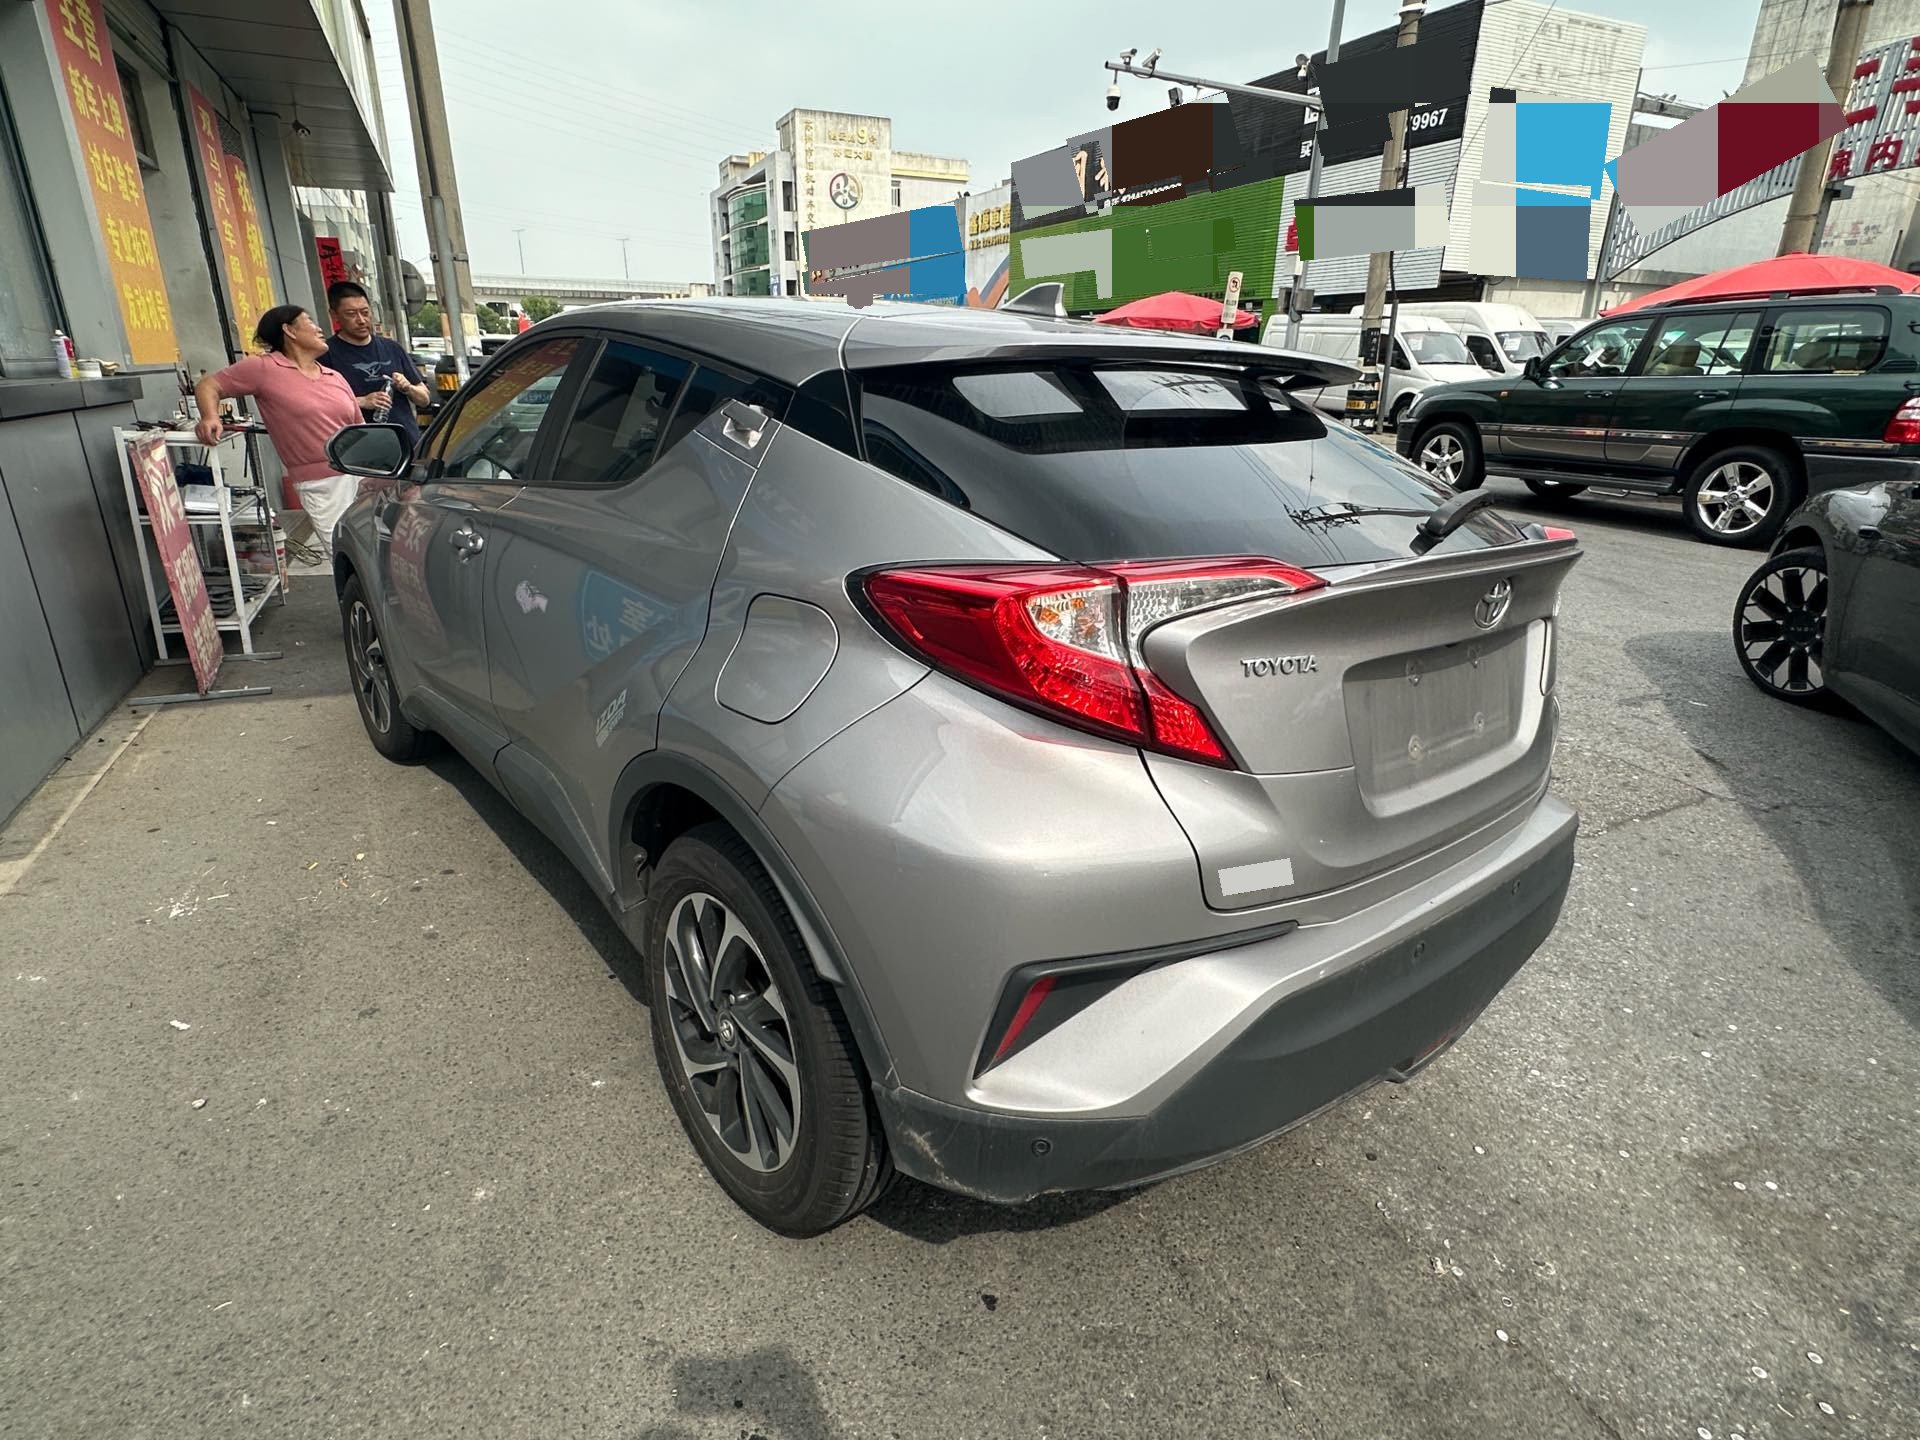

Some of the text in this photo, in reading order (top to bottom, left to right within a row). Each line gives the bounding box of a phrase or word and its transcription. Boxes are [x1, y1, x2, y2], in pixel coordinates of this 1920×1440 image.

[67, 62, 125, 141] 新车上牌
[1410, 108, 1448, 131] 9967
[87, 141, 140, 207] 过户验车
[122, 281, 169, 331] 发动机号
[1240, 654, 1319, 678] TOYOTA
